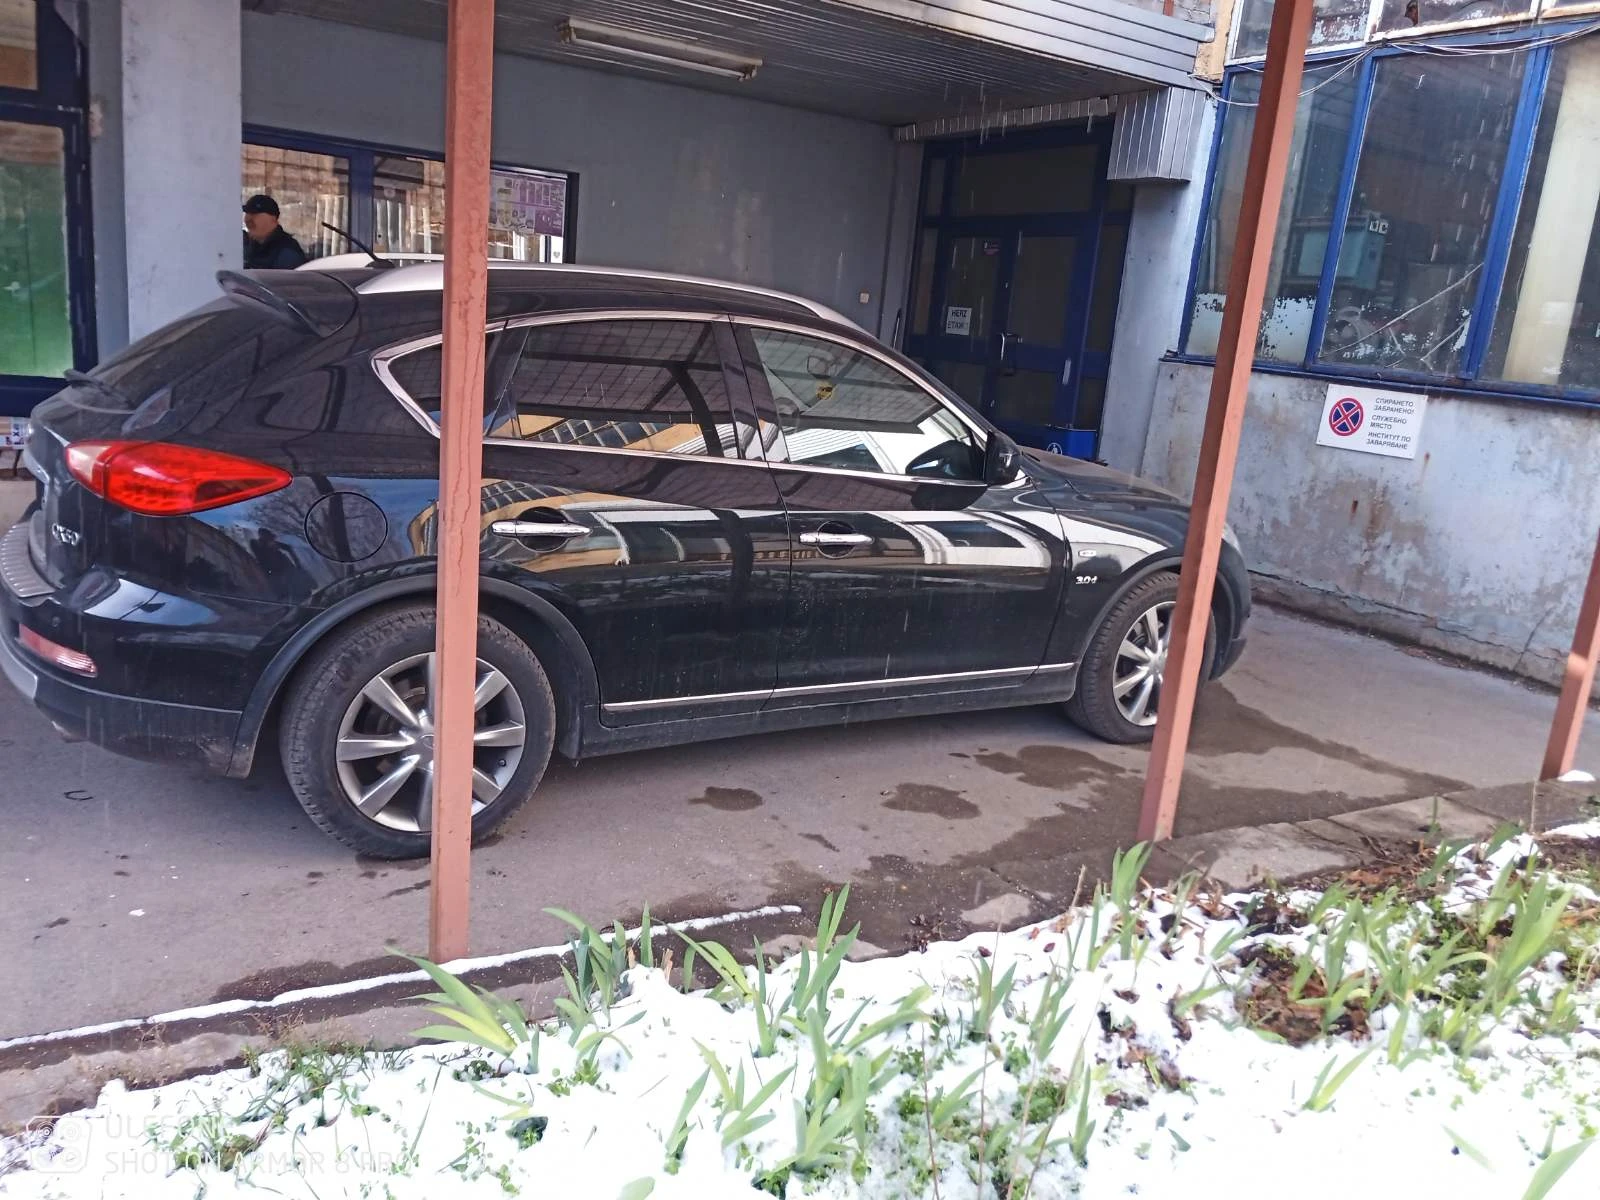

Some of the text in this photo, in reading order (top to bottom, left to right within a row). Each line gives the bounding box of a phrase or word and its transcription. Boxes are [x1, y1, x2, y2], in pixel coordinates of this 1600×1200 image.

[1375, 397, 1414, 407] СПИРАНЕТО
[1374, 405, 1415, 416] ЗАБРАНЕНО!
[1371, 414, 1407, 425] СЛУЖЕБНО
[1370, 421, 1392, 430] МЯСТО
[1368, 431, 1400, 441] ИНСТИТУТ
[1366, 438, 1408, 449] ЗАВАРЯВАНЕ
